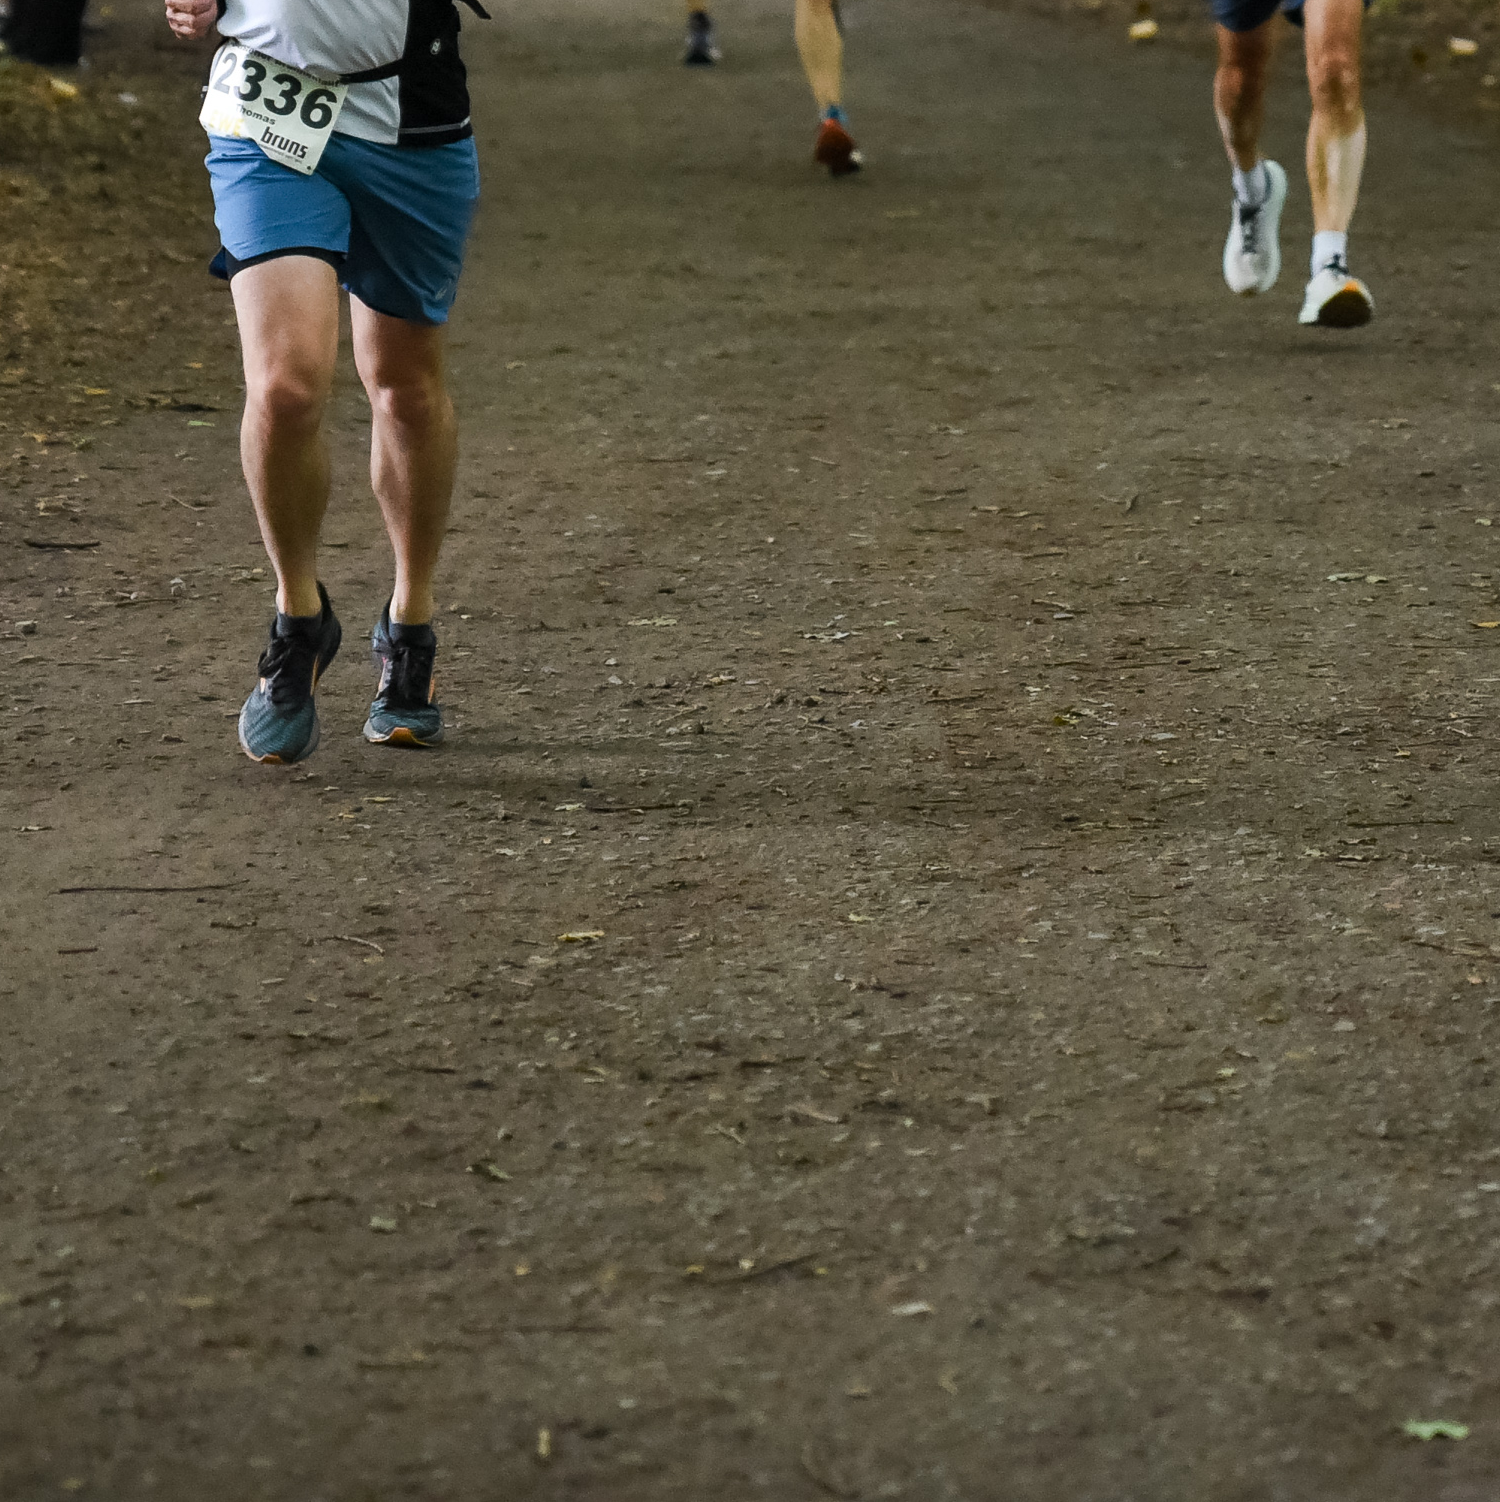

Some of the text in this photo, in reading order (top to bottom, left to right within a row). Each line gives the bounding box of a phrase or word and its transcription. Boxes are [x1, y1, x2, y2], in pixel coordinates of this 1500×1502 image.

[213, 52, 338, 130] 2336
[236, 103, 277, 126] Thomas
[260, 126, 309, 160] bruns
